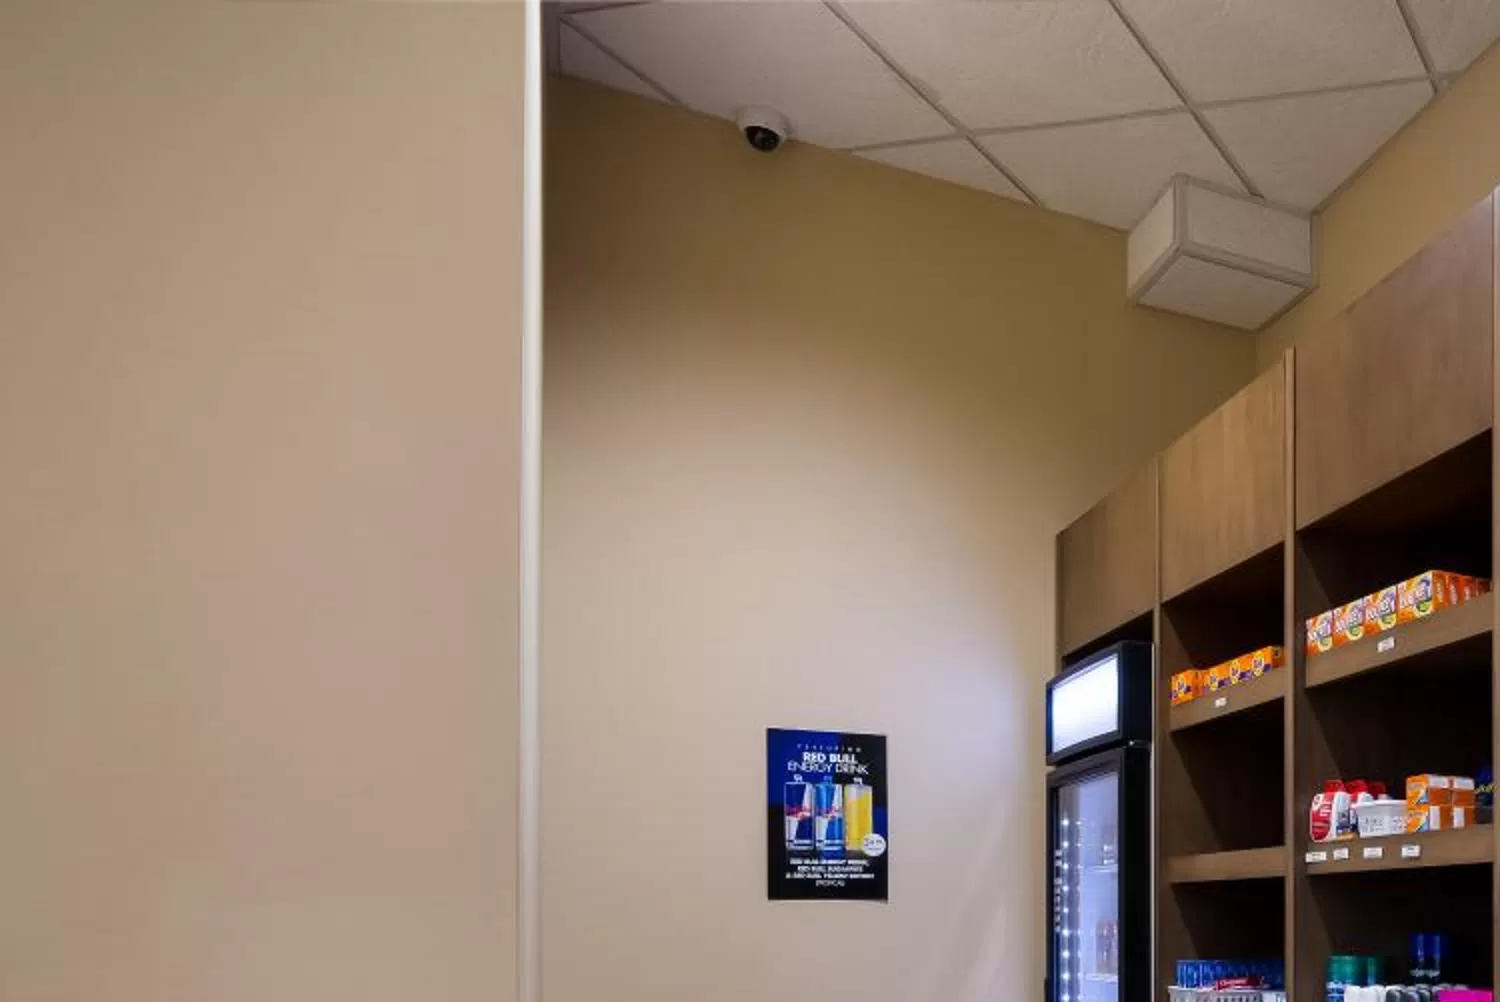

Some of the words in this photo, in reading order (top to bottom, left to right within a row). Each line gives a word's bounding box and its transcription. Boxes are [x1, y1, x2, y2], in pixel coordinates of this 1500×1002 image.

[803, 752, 827, 764] RED
[829, 753, 858, 764] BULL
[787, 760, 833, 773] ENERGY
[835, 763, 869, 775] DRINK
